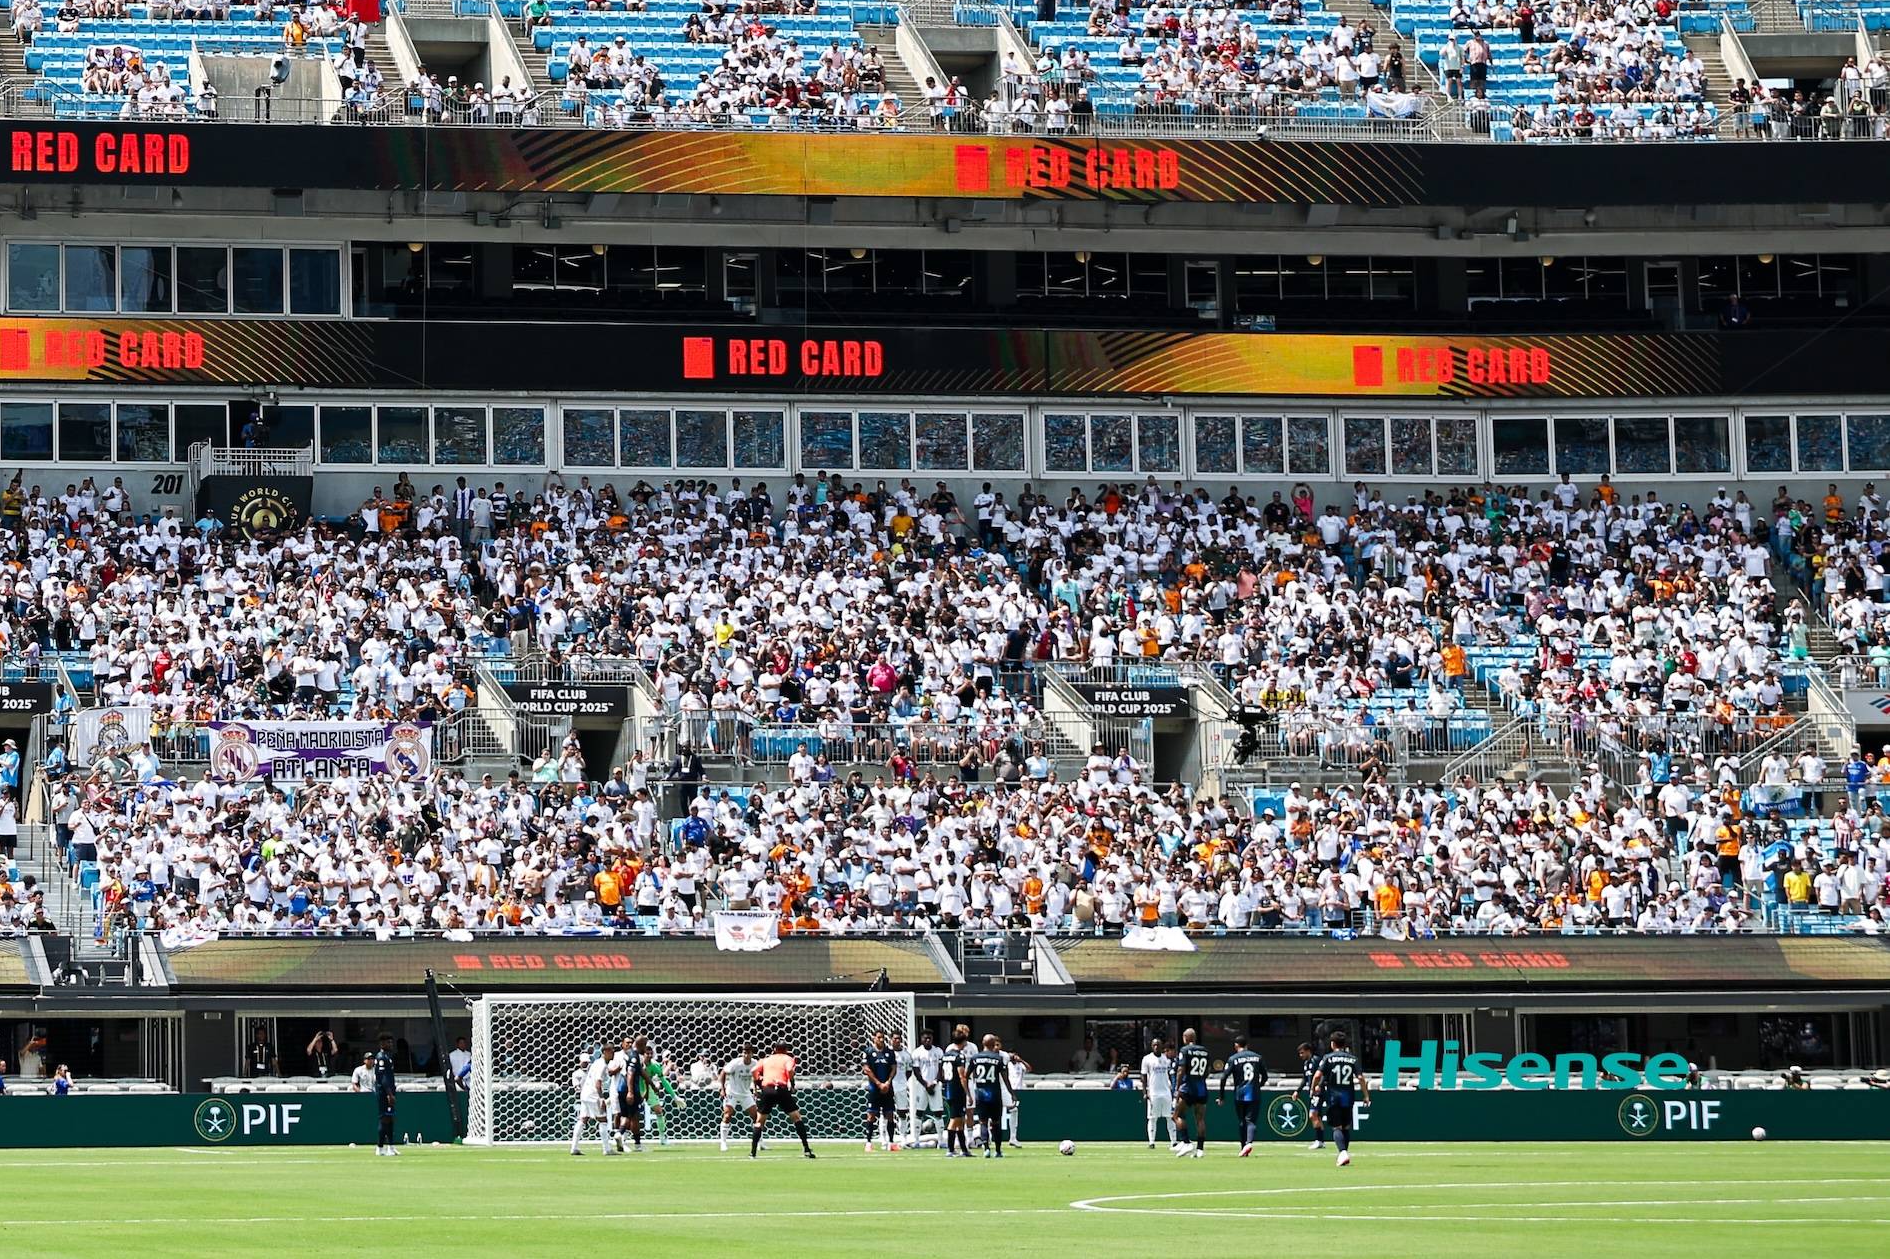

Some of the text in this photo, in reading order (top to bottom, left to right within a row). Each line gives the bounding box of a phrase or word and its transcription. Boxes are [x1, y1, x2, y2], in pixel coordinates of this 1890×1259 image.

[11, 131, 189, 174] RED CARD
[1006, 148, 1179, 190] RED CARD
[45, 330, 204, 369] RED CARD
[729, 340, 883, 377] RED CARD
[1396, 346, 1550, 385] RED CARD
[152, 474, 183, 495] 201
[239, 487, 279, 504] WORLD
[530, 689, 588, 700] FIFA CLUB
[1094, 691, 1151, 702] FIFA CLUB
[554, 702, 578, 713] CUP
[1122, 703, 1142, 714] CUP
[256, 728, 385, 750] PEÑA MADRIDISTA
[488, 954, 632, 969] RED CARD
[976, 1064, 997, 1084] 24
[1190, 1056, 1208, 1076] 29
[1332, 1064, 1353, 1085] 12
[1381, 1039, 1690, 1091] Hisense
[242, 1104, 302, 1135] PIF
[1663, 1100, 1720, 1131] PIF
